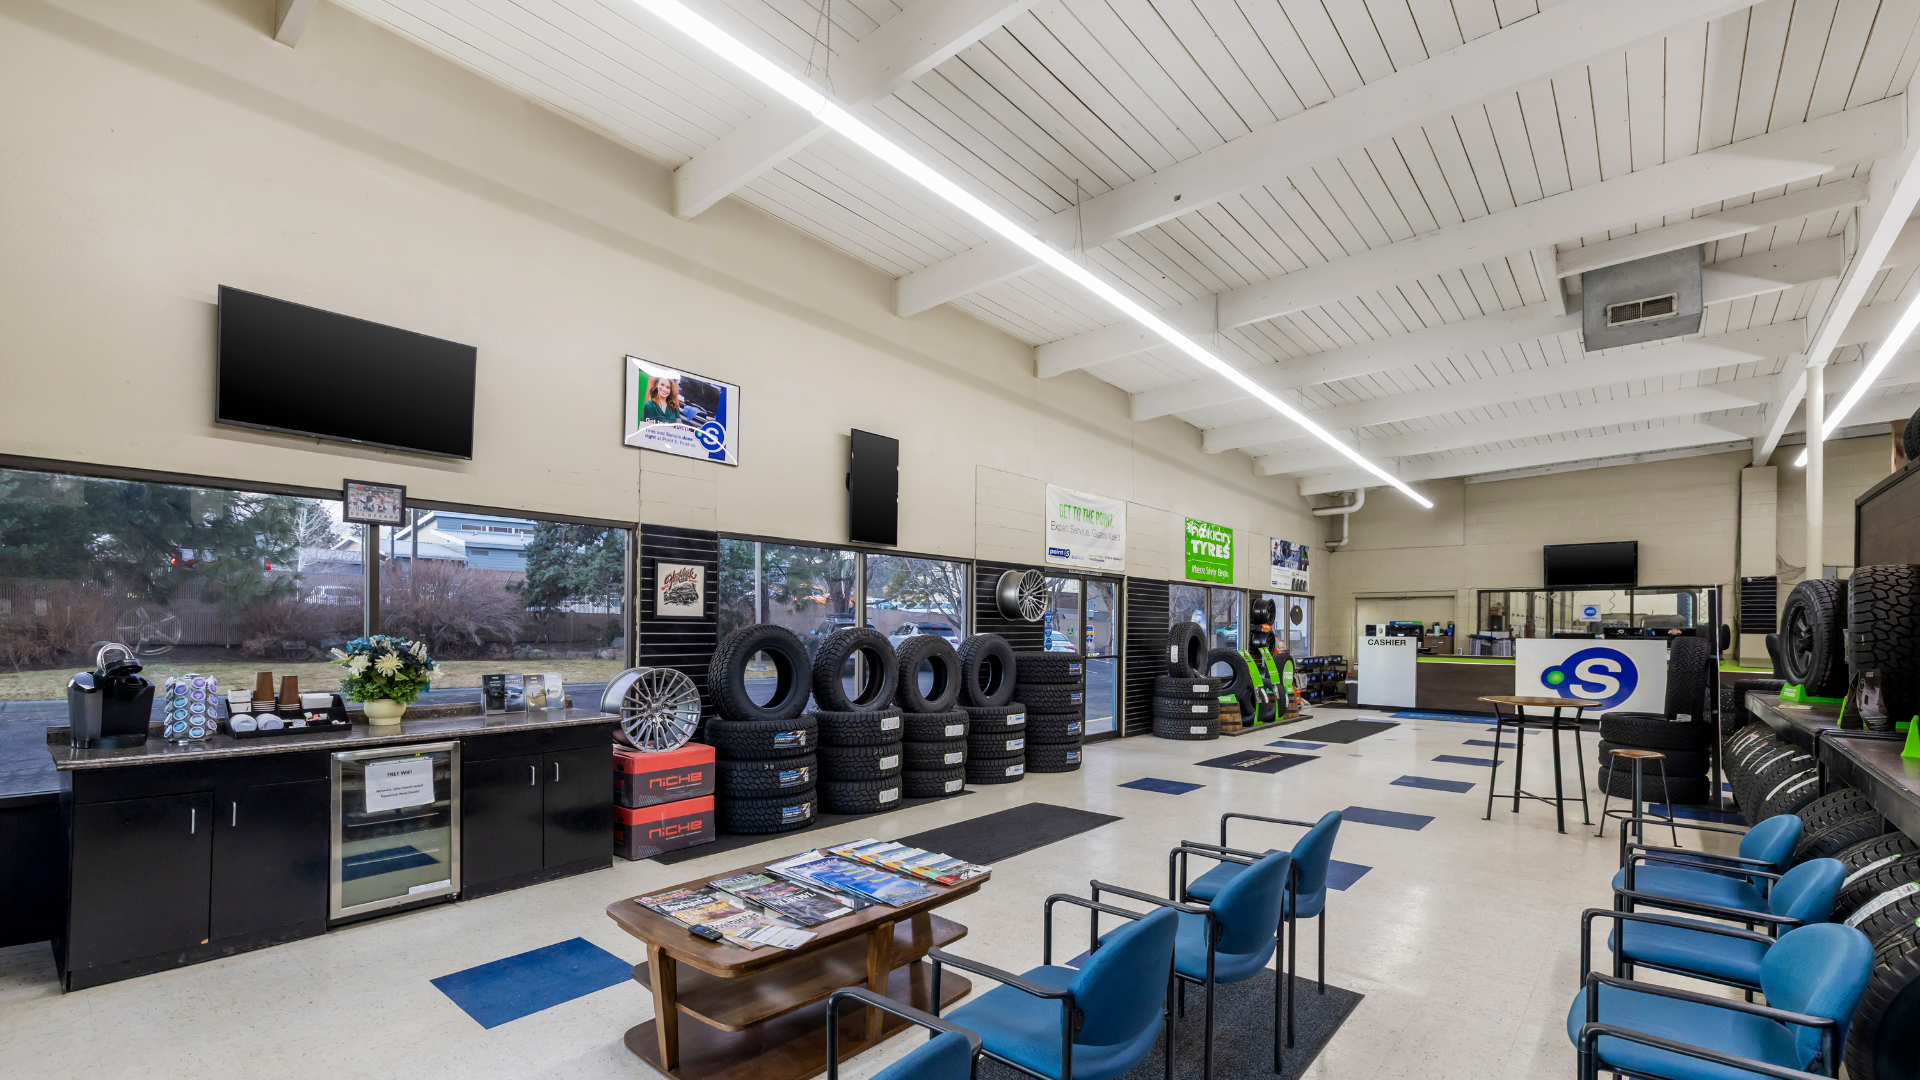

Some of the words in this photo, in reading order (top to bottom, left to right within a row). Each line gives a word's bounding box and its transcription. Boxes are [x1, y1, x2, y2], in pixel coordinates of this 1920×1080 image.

[662, 436, 673, 444] Point
[1059, 503, 1072, 519] GET
[1073, 506, 1081, 521] TO
[1083, 508, 1094, 524] THE
[1050, 520, 1069, 533] Expert
[1050, 548, 1064, 556] point
[1191, 539, 1230, 559] TYRES
[1367, 638, 1407, 646] CASHIER
[1569, 657, 1622, 699] S
